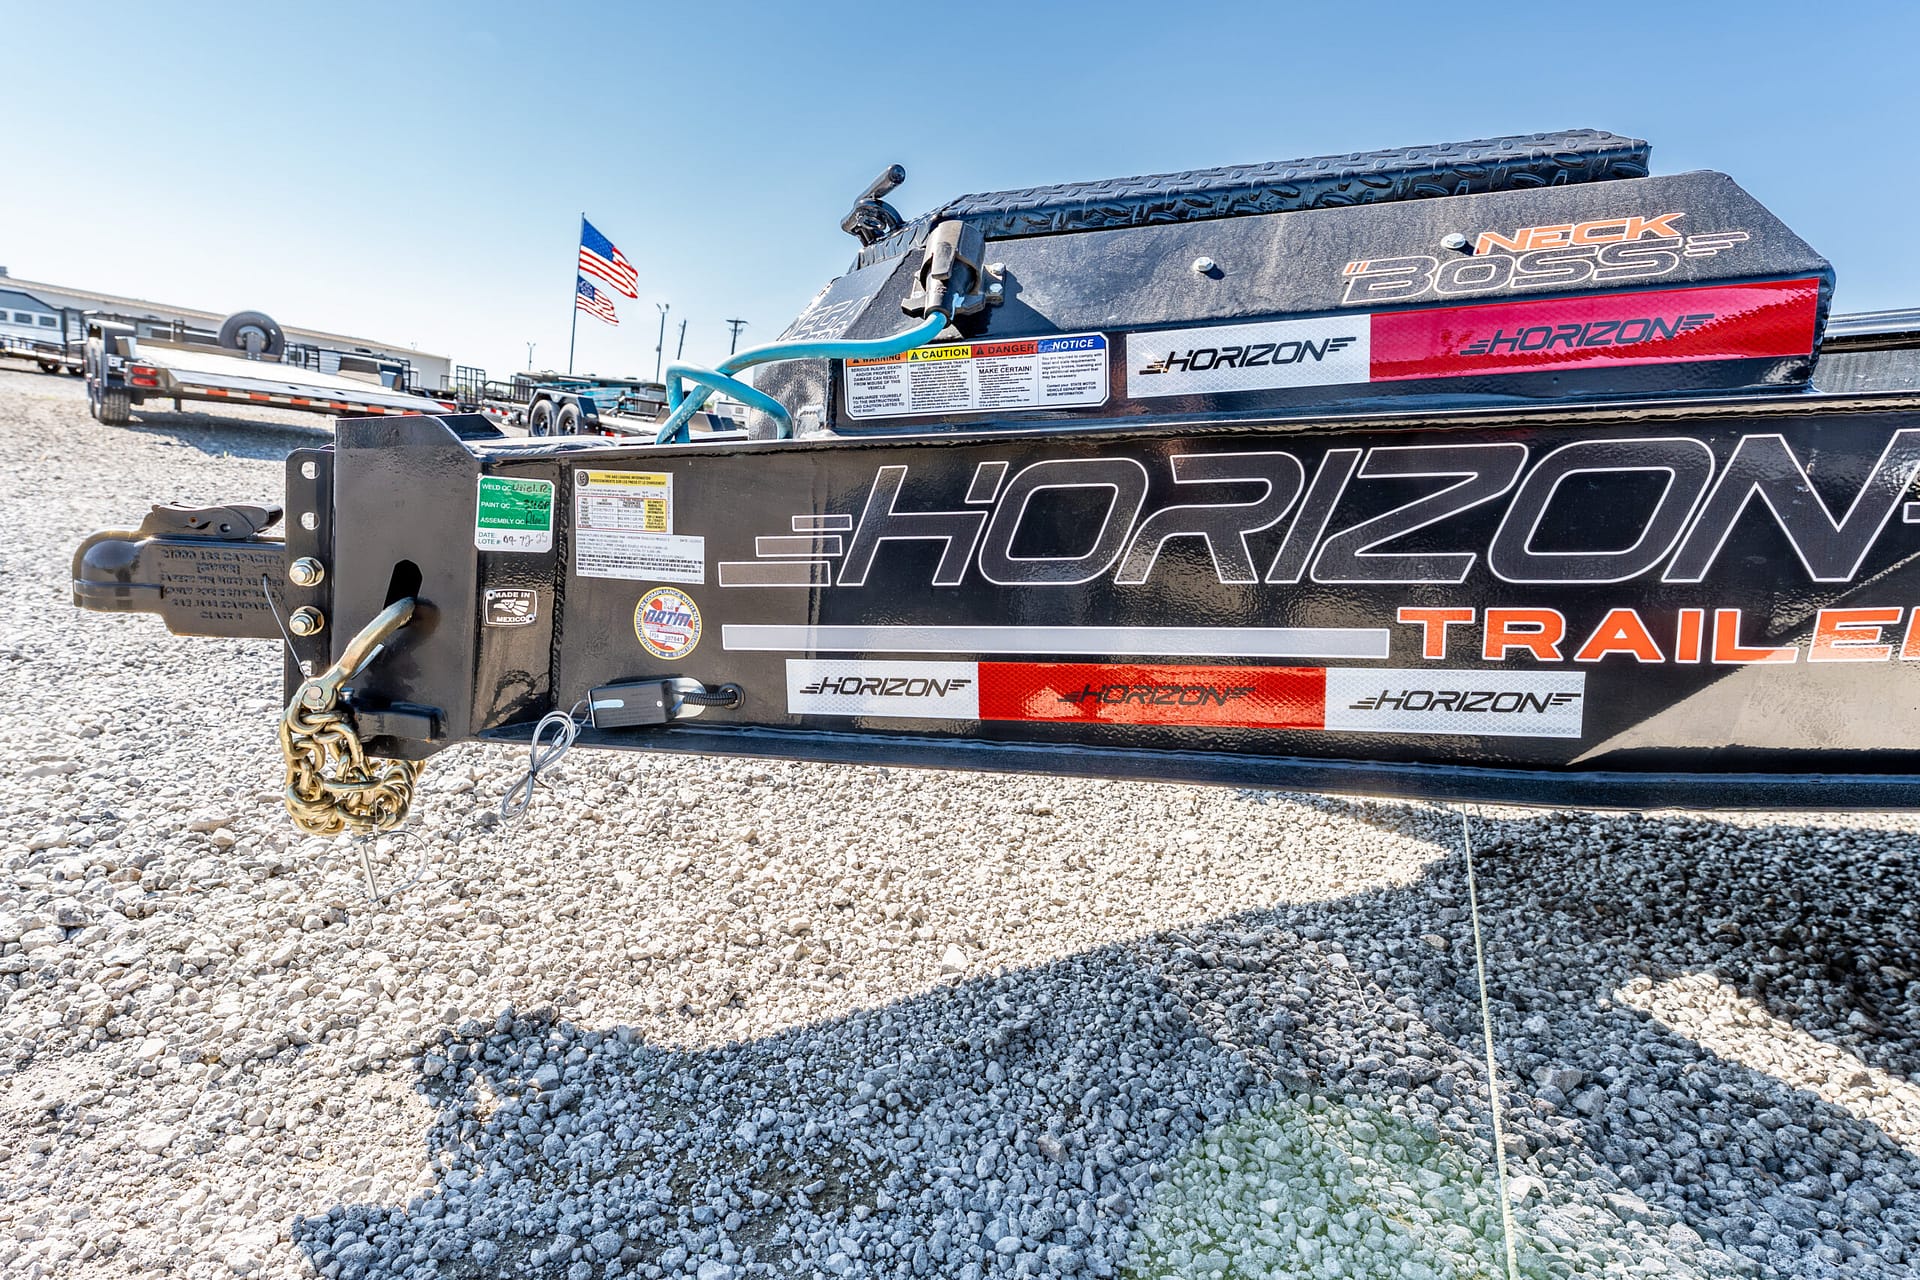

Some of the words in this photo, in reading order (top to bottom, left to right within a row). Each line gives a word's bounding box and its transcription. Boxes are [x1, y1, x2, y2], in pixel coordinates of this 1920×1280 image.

[1473, 213, 1686, 256] NECK
[1342, 238, 1683, 304] BOSS
[987, 344, 1034, 355] DANGER
[1052, 339, 1094, 350] NOTICE
[1486, 315, 1684, 355] HORIZON
[921, 348, 969, 359] CAUTION
[1163, 338, 1331, 374] HORIZON
[837, 428, 1920, 587] HORIZON
[1397, 607, 1920, 664] TRAILE
[818, 676, 952, 698] HORIZON
[1077, 683, 1240, 707] HORIZON
[1373, 689, 1551, 714] HORIZON
